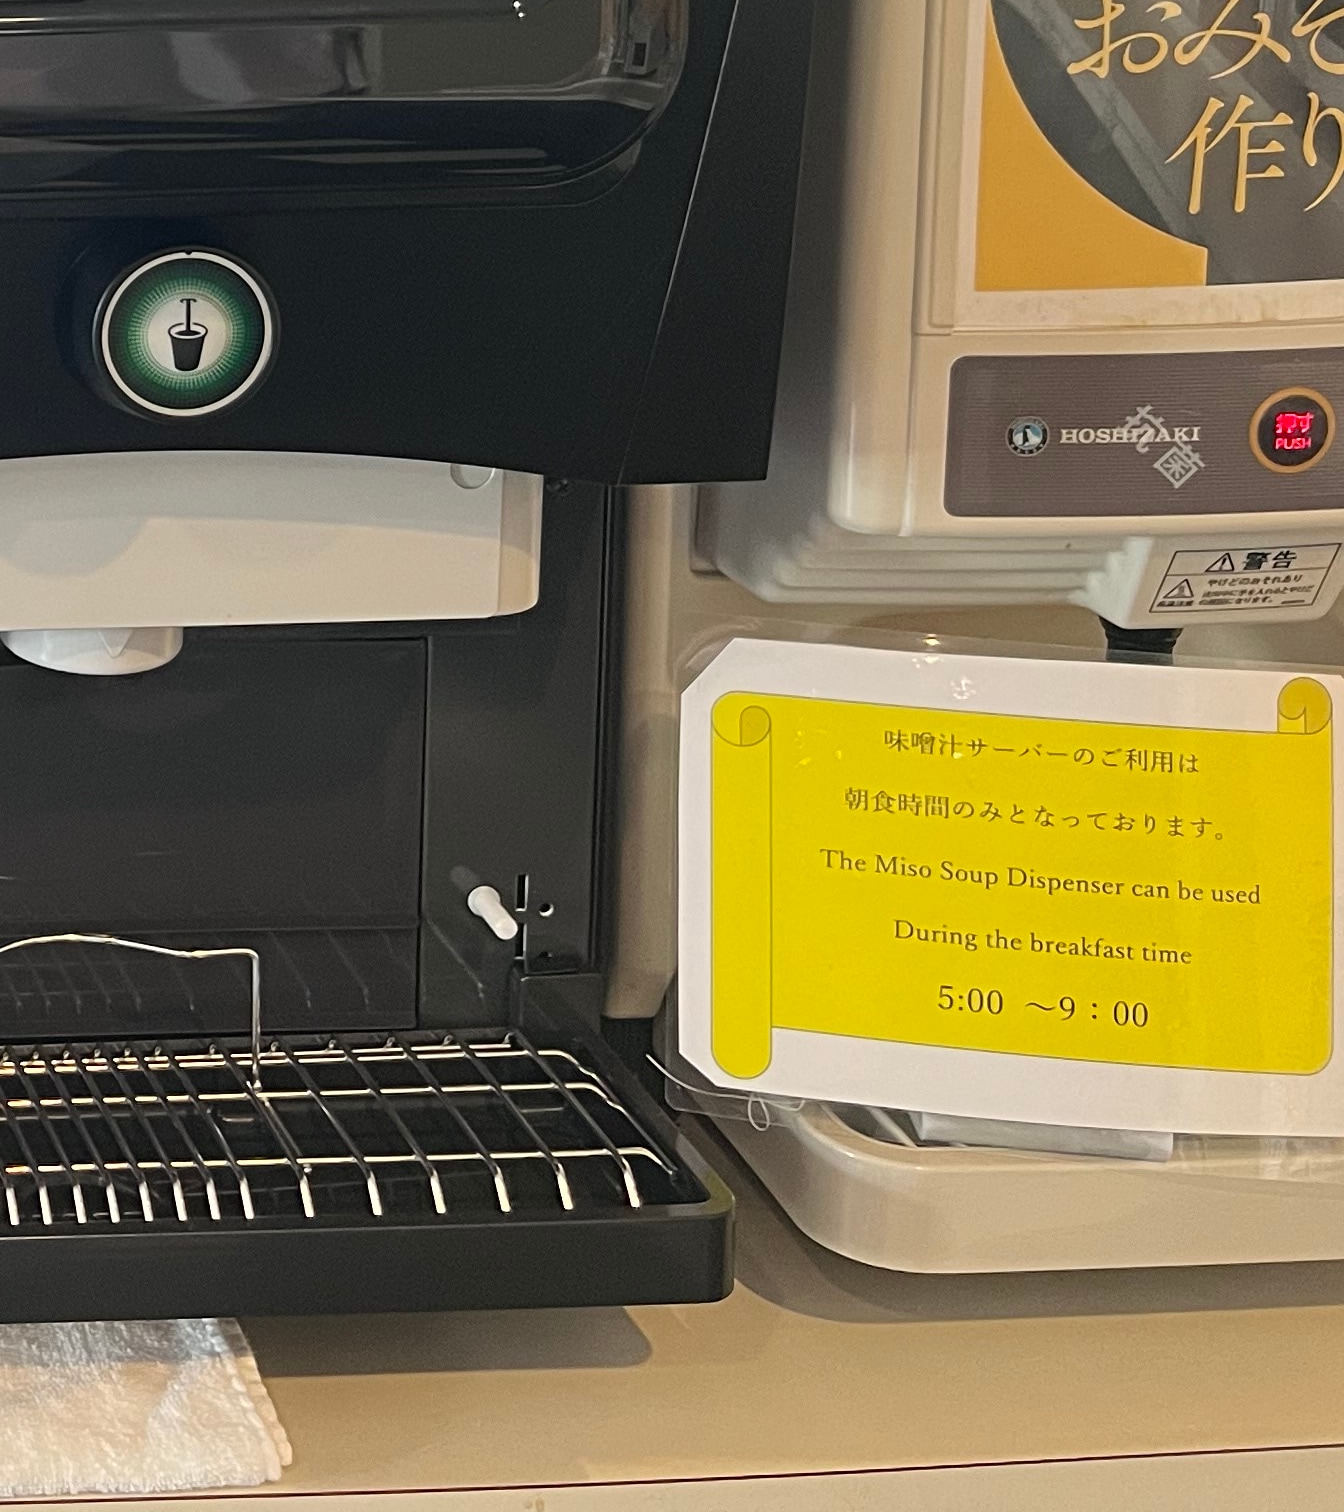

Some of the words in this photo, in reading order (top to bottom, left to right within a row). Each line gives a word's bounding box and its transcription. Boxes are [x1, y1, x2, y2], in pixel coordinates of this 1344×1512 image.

[1059, 426, 1201, 444] HOSHIZAKI
[1275, 437, 1312, 450] PUSH
[883, 728, 1200, 775] 味噌汁サーバーのご利用は
[844, 786, 1225, 842] 朝食時間のみとなっております。
[819, 848, 867, 872] The
[874, 853, 932, 879] Miso
[940, 861, 999, 890] Soup
[1007, 866, 1125, 896] Dispenser
[1131, 881, 1170, 900] can
[1178, 879, 1204, 901] be
[1211, 884, 1261, 905] used
[893, 919, 978, 952] During
[986, 929, 1022, 951] the
[1030, 932, 1135, 962] breakfast
[1141, 942, 1193, 965] time
[936, 984, 1004, 1016] 5:00
